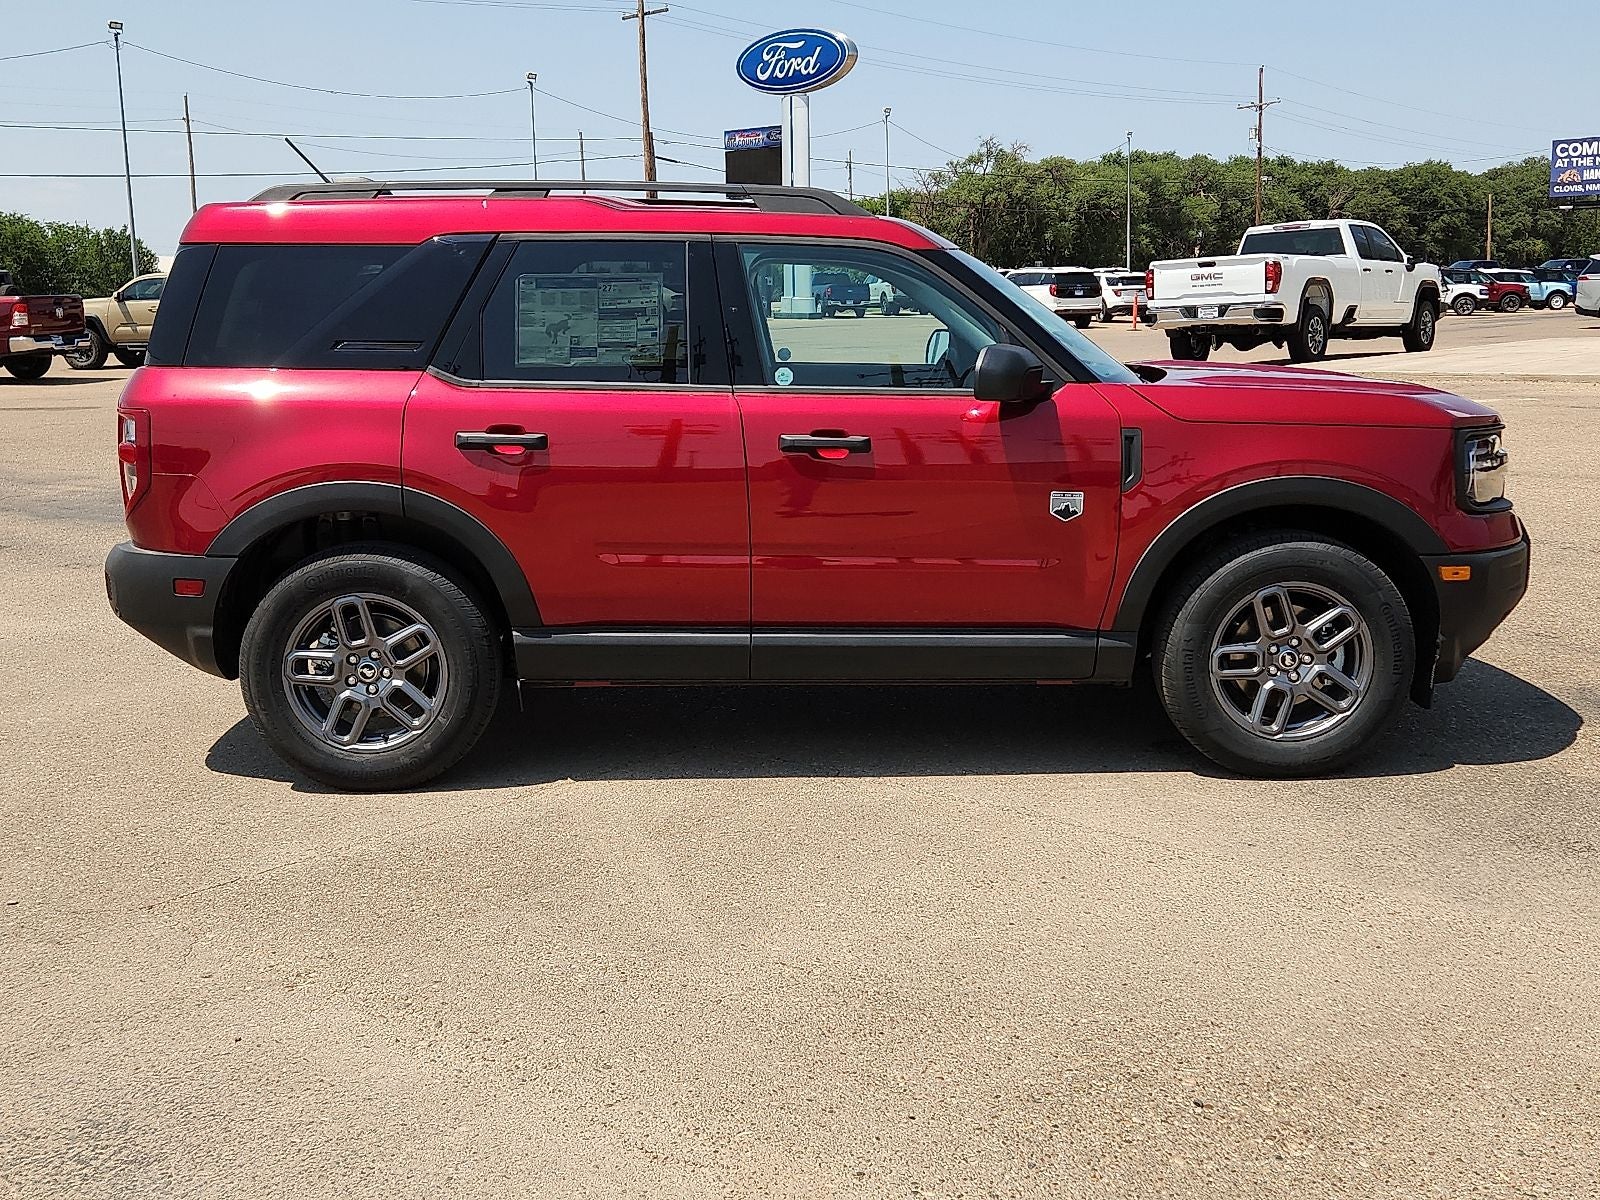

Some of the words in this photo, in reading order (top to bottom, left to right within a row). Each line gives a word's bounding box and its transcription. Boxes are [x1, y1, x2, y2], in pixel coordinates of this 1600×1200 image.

[757, 40, 822, 80] Ford
[737, 137, 764, 147] COUNTRY
[1555, 158, 1569, 168] AT
[1571, 156, 1593, 167] THE
[1554, 184, 1584, 193] CLOVIS,
[1191, 272, 1223, 281] GMC
[602, 284, 612, 292] 27
